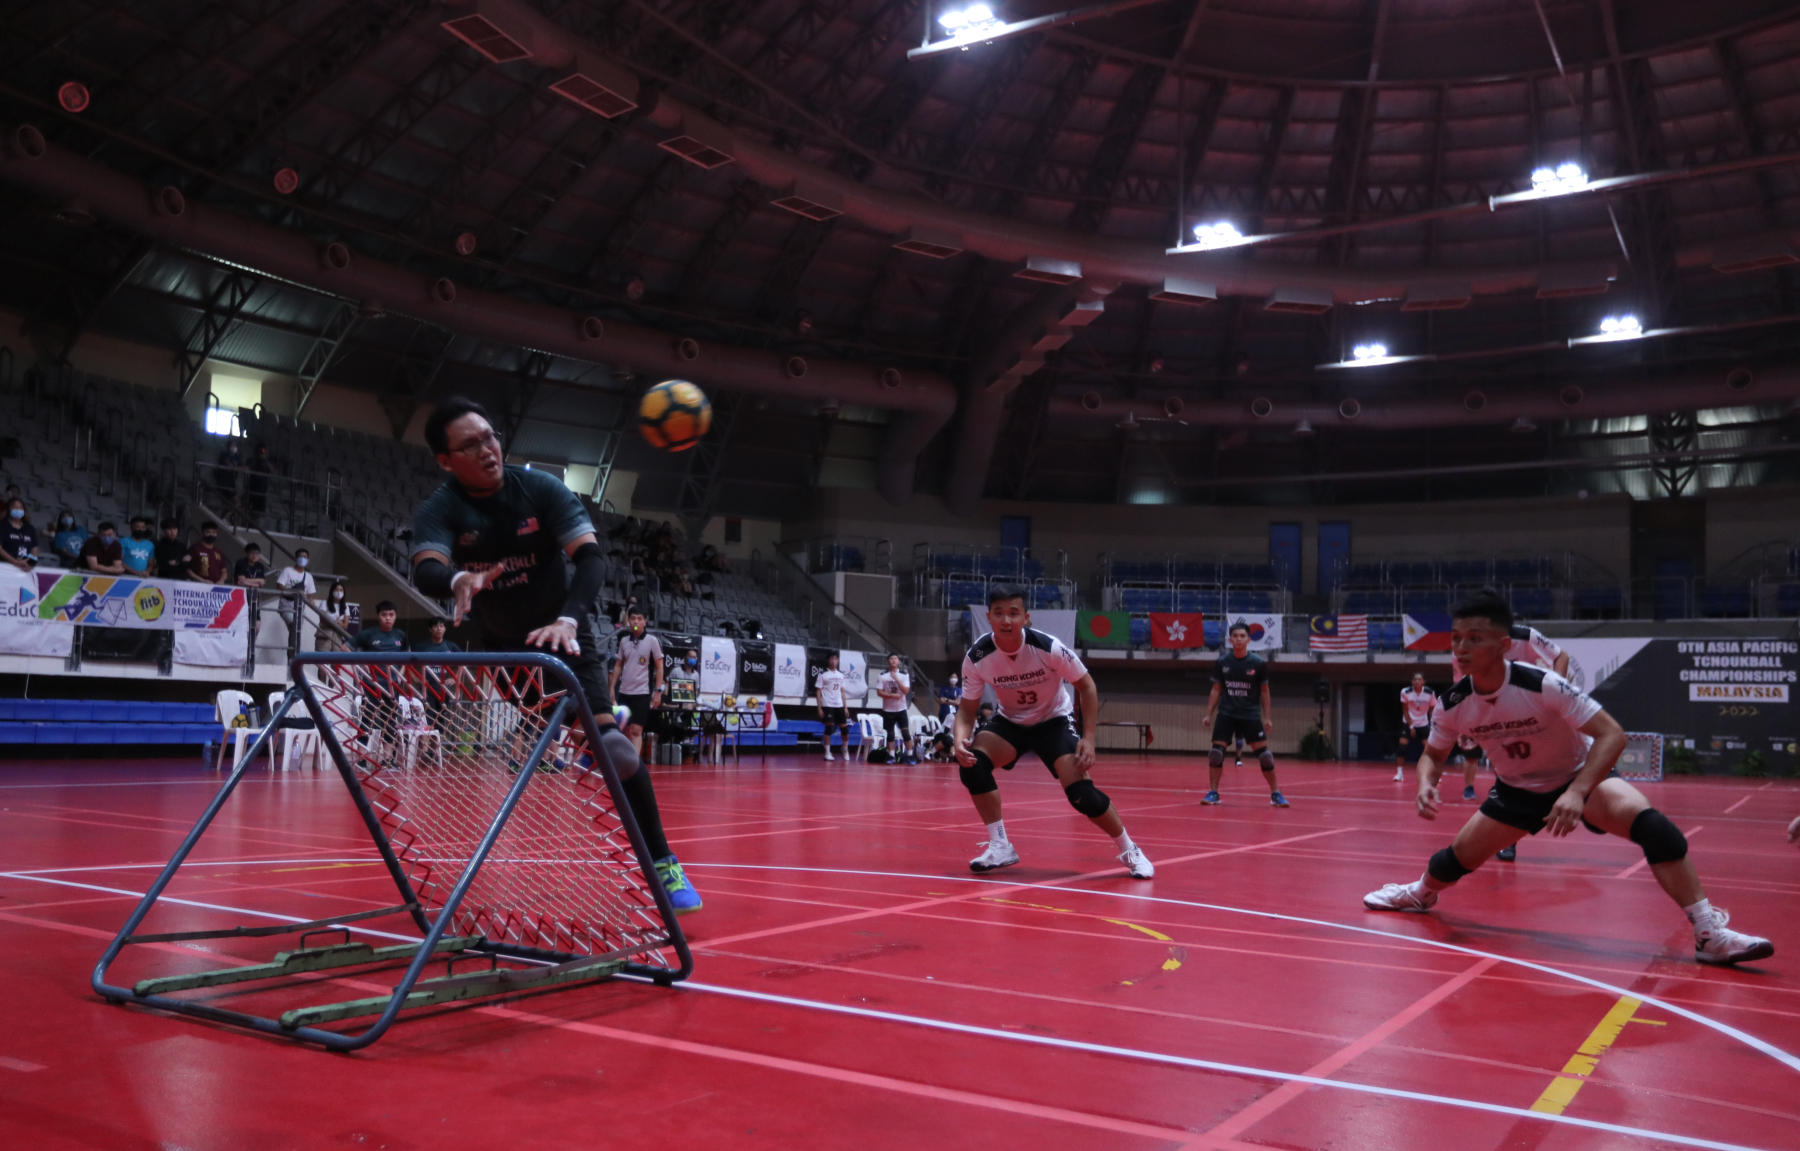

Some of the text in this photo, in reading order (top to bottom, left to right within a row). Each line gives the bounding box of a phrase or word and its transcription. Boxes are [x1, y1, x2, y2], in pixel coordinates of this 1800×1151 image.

[173, 589, 232, 602] INTERNATIONAL
[140, 595, 160, 610] fitb
[173, 598, 222, 609] TCHOUKBALL
[173, 607, 219, 617] FEDERATION
[1677, 641, 1798, 654] 9TH ASIA PACIFIC
[705, 660, 731, 672] EduCity
[1692, 655, 1782, 668] TCHOUKBALL
[779, 665, 801, 677] EduCity
[993, 668, 1045, 684] HONG KONG
[1679, 669, 1797, 683] CHAMPIONSHIPS
[1017, 690, 1038, 705] 33
[1697, 686, 1783, 698] MALAYSIA
[1719, 705, 1760, 716] 2022
[1469, 722, 1503, 734] HONG
[1504, 716, 1538, 729] KONG
